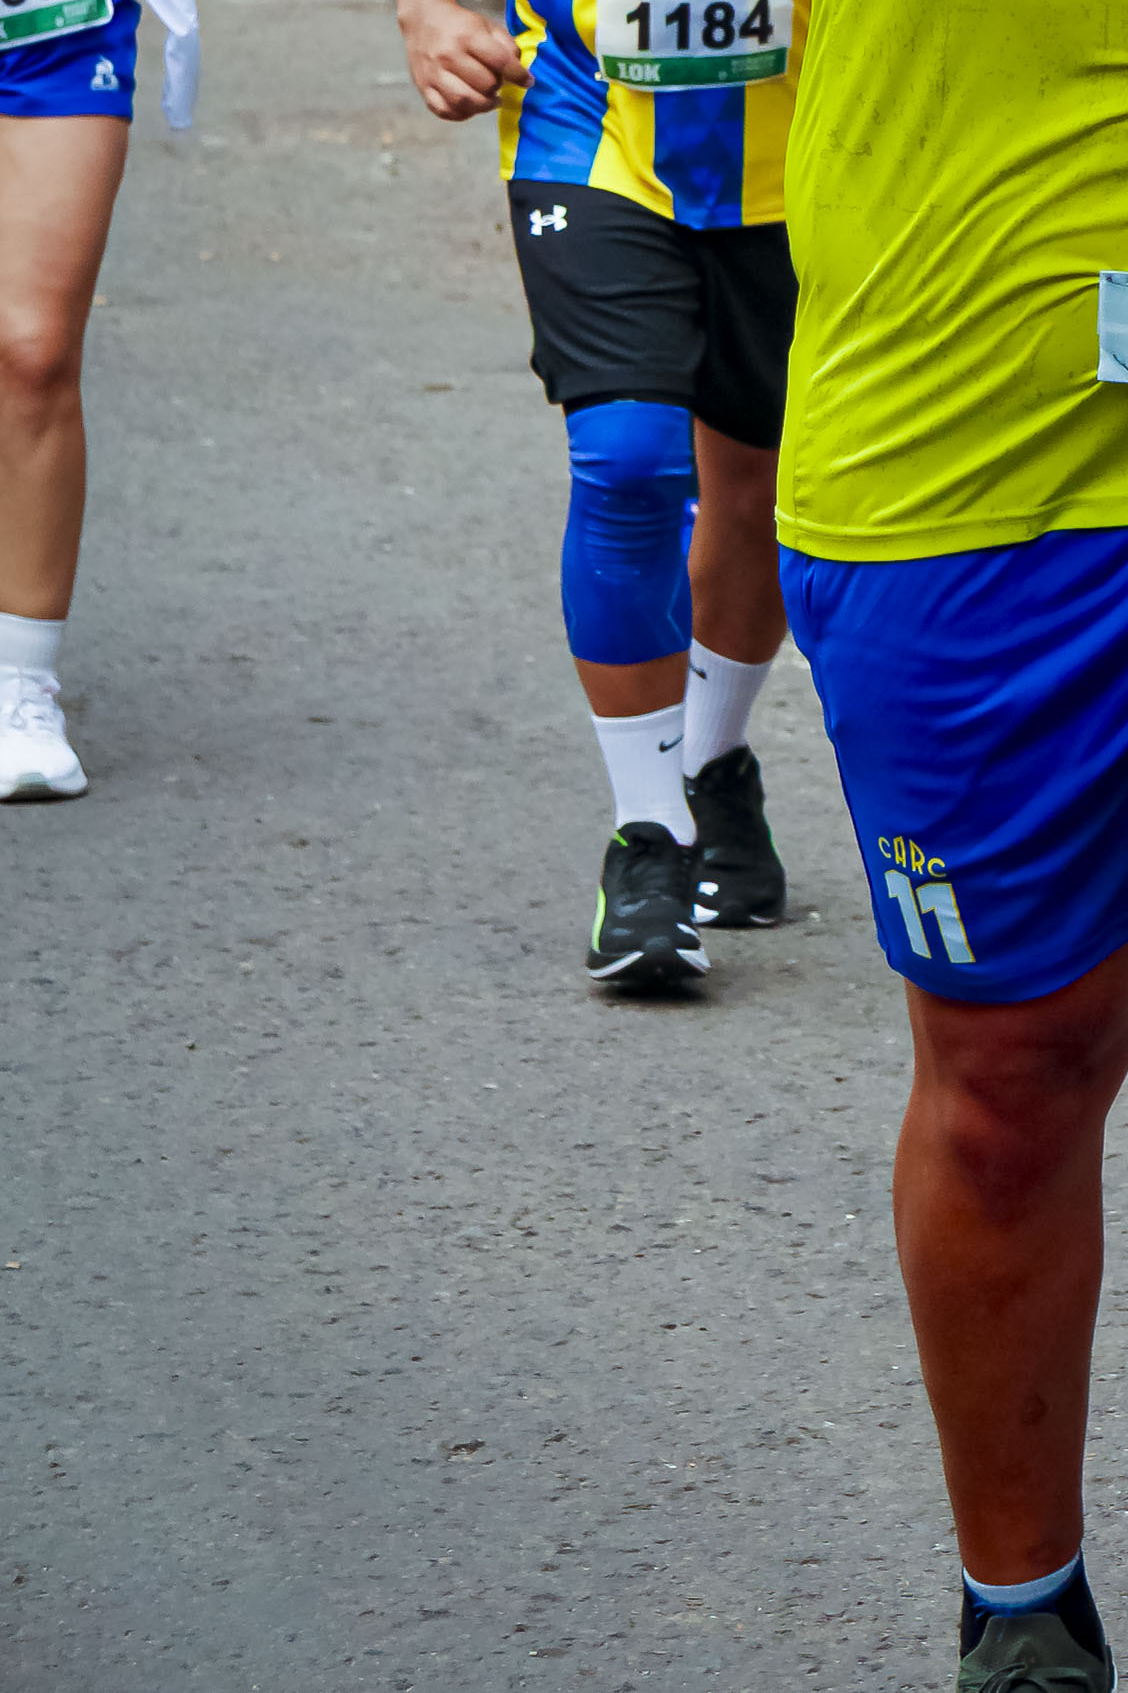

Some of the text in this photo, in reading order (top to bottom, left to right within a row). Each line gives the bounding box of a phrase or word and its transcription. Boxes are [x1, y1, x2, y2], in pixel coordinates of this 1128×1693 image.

[617, 62, 662, 82] 10K
[878, 836, 947, 878] CARC
[884, 869, 976, 963] 11
